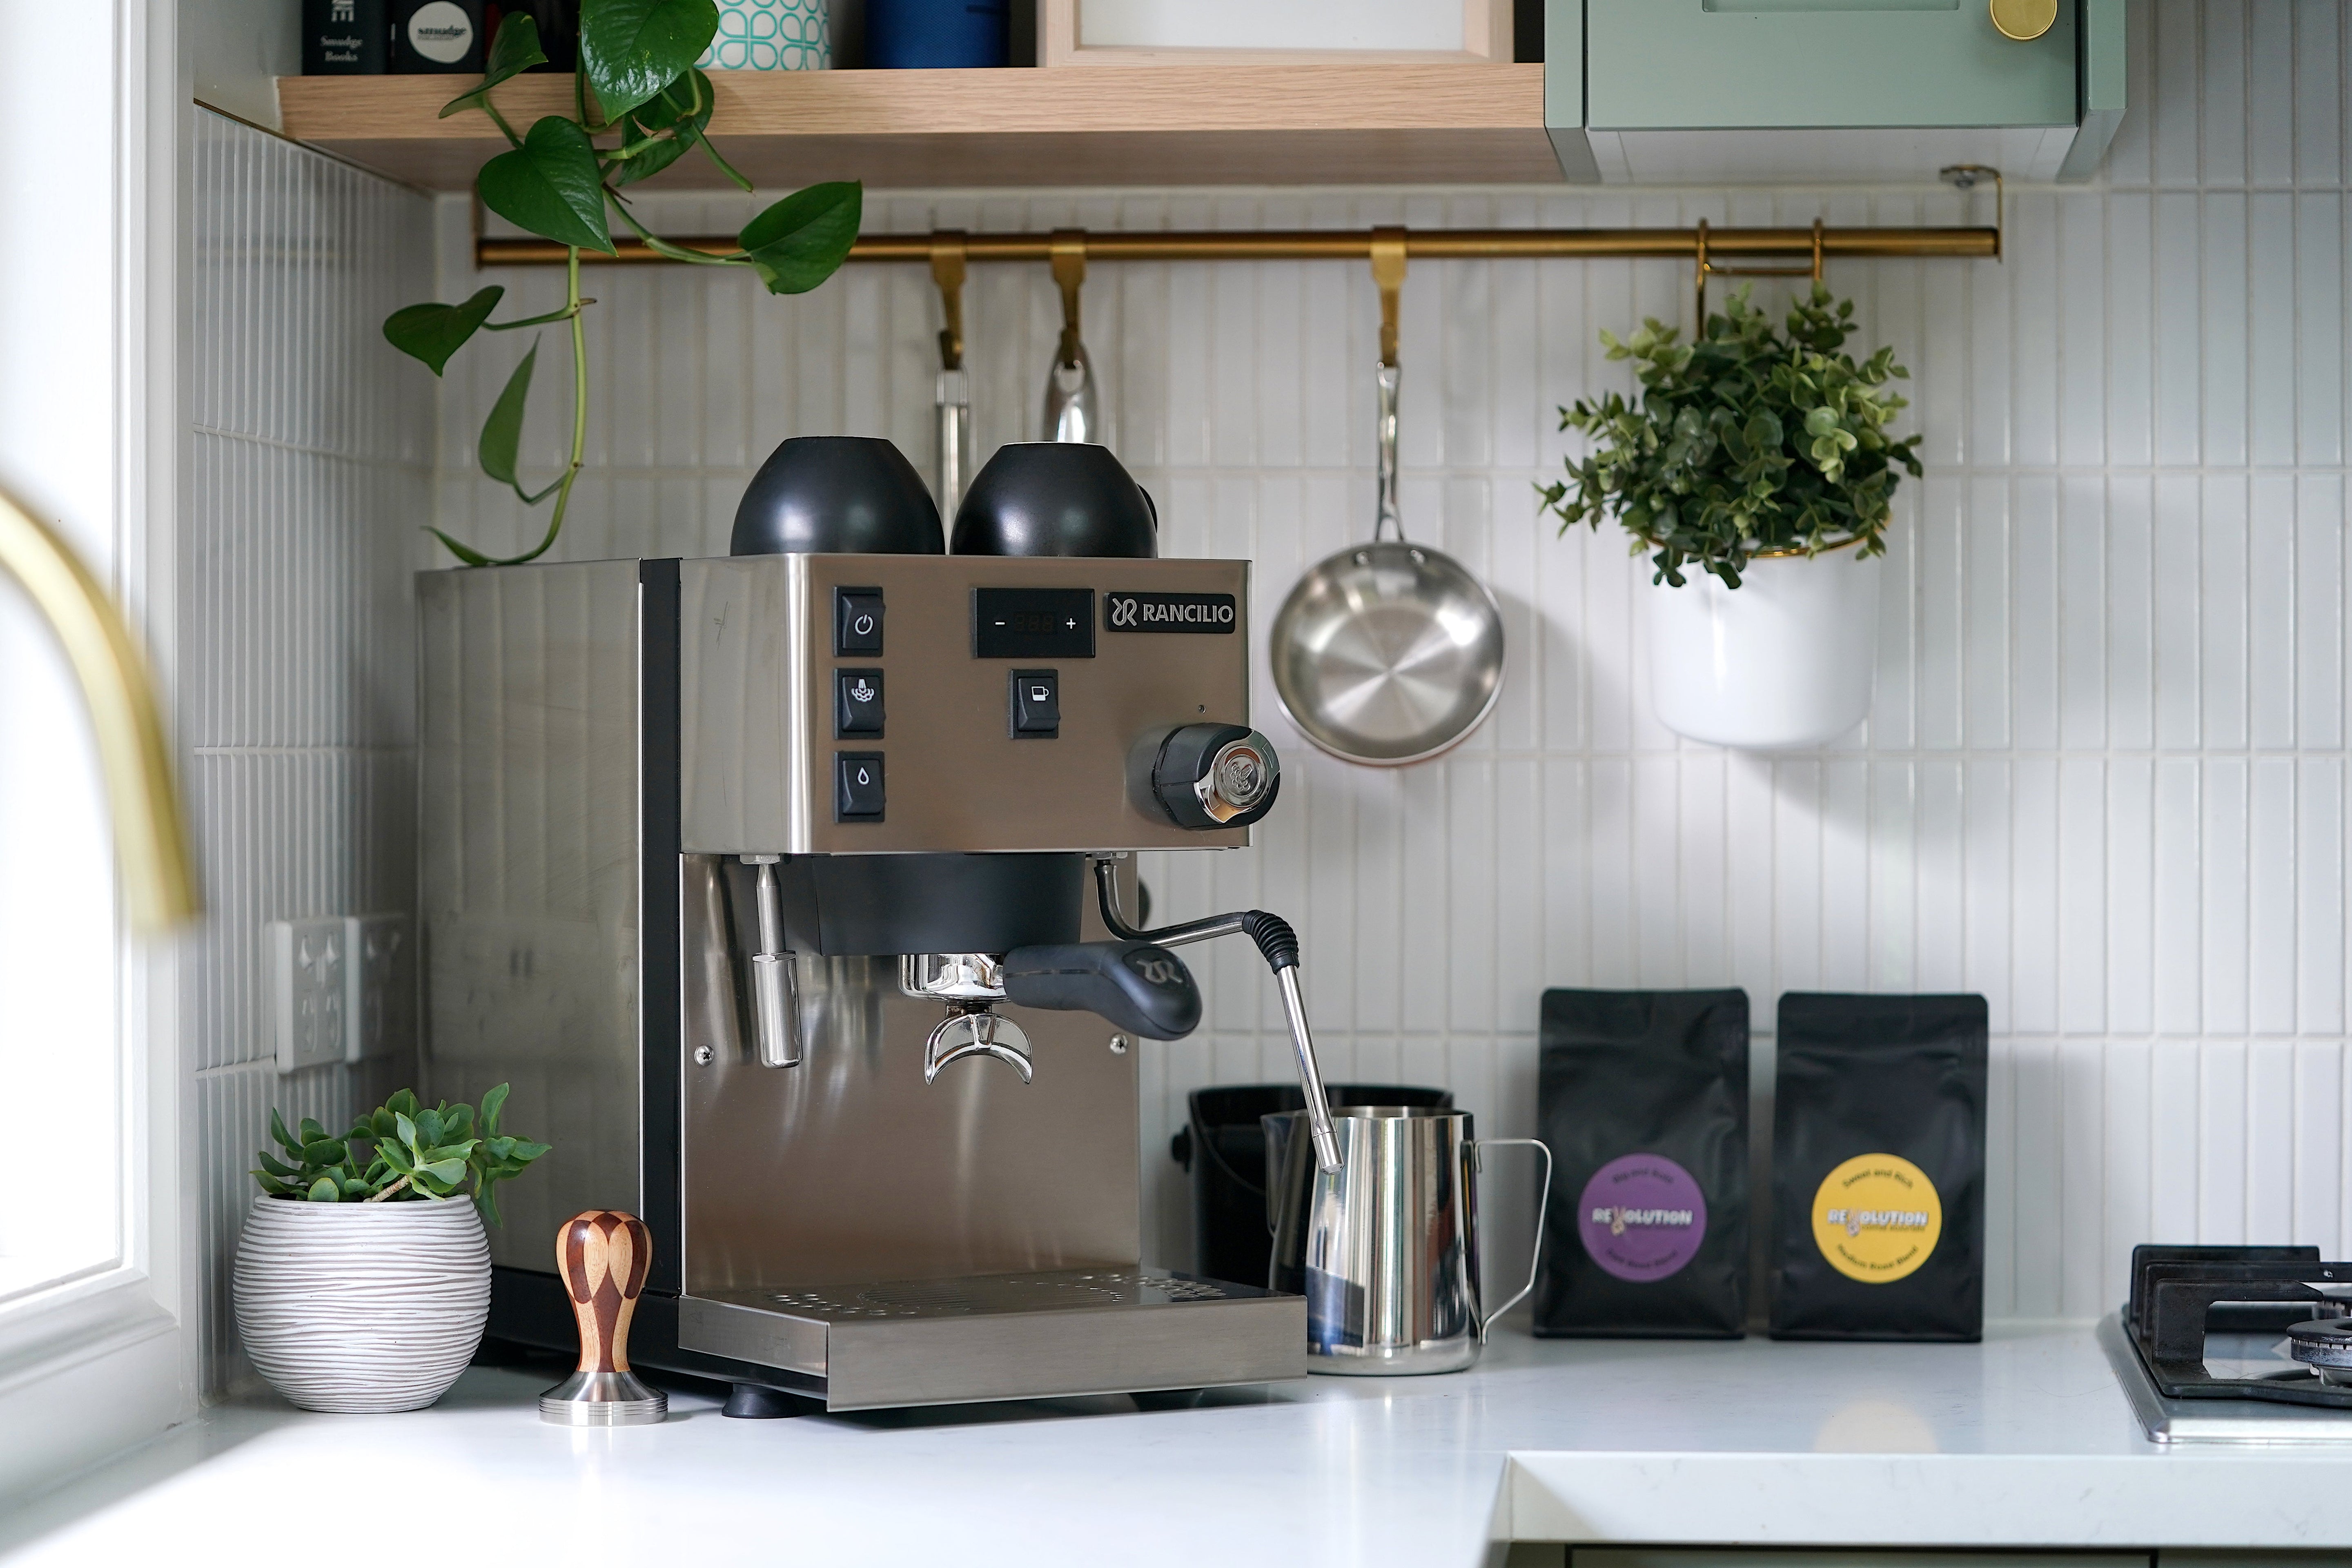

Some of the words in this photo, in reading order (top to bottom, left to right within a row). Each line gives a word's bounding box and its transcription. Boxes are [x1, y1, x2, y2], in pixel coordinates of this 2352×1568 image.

[418, 24, 467, 38] smudge
[320, 35, 363, 49] Smudge
[325, 51, 358, 61] Books
[1143, 604, 1233, 623] RANCILIO
[1842, 1169, 1871, 1189] Sweet
[1873, 1169, 1893, 1178] and
[1894, 1170, 1913, 1189] Rich
